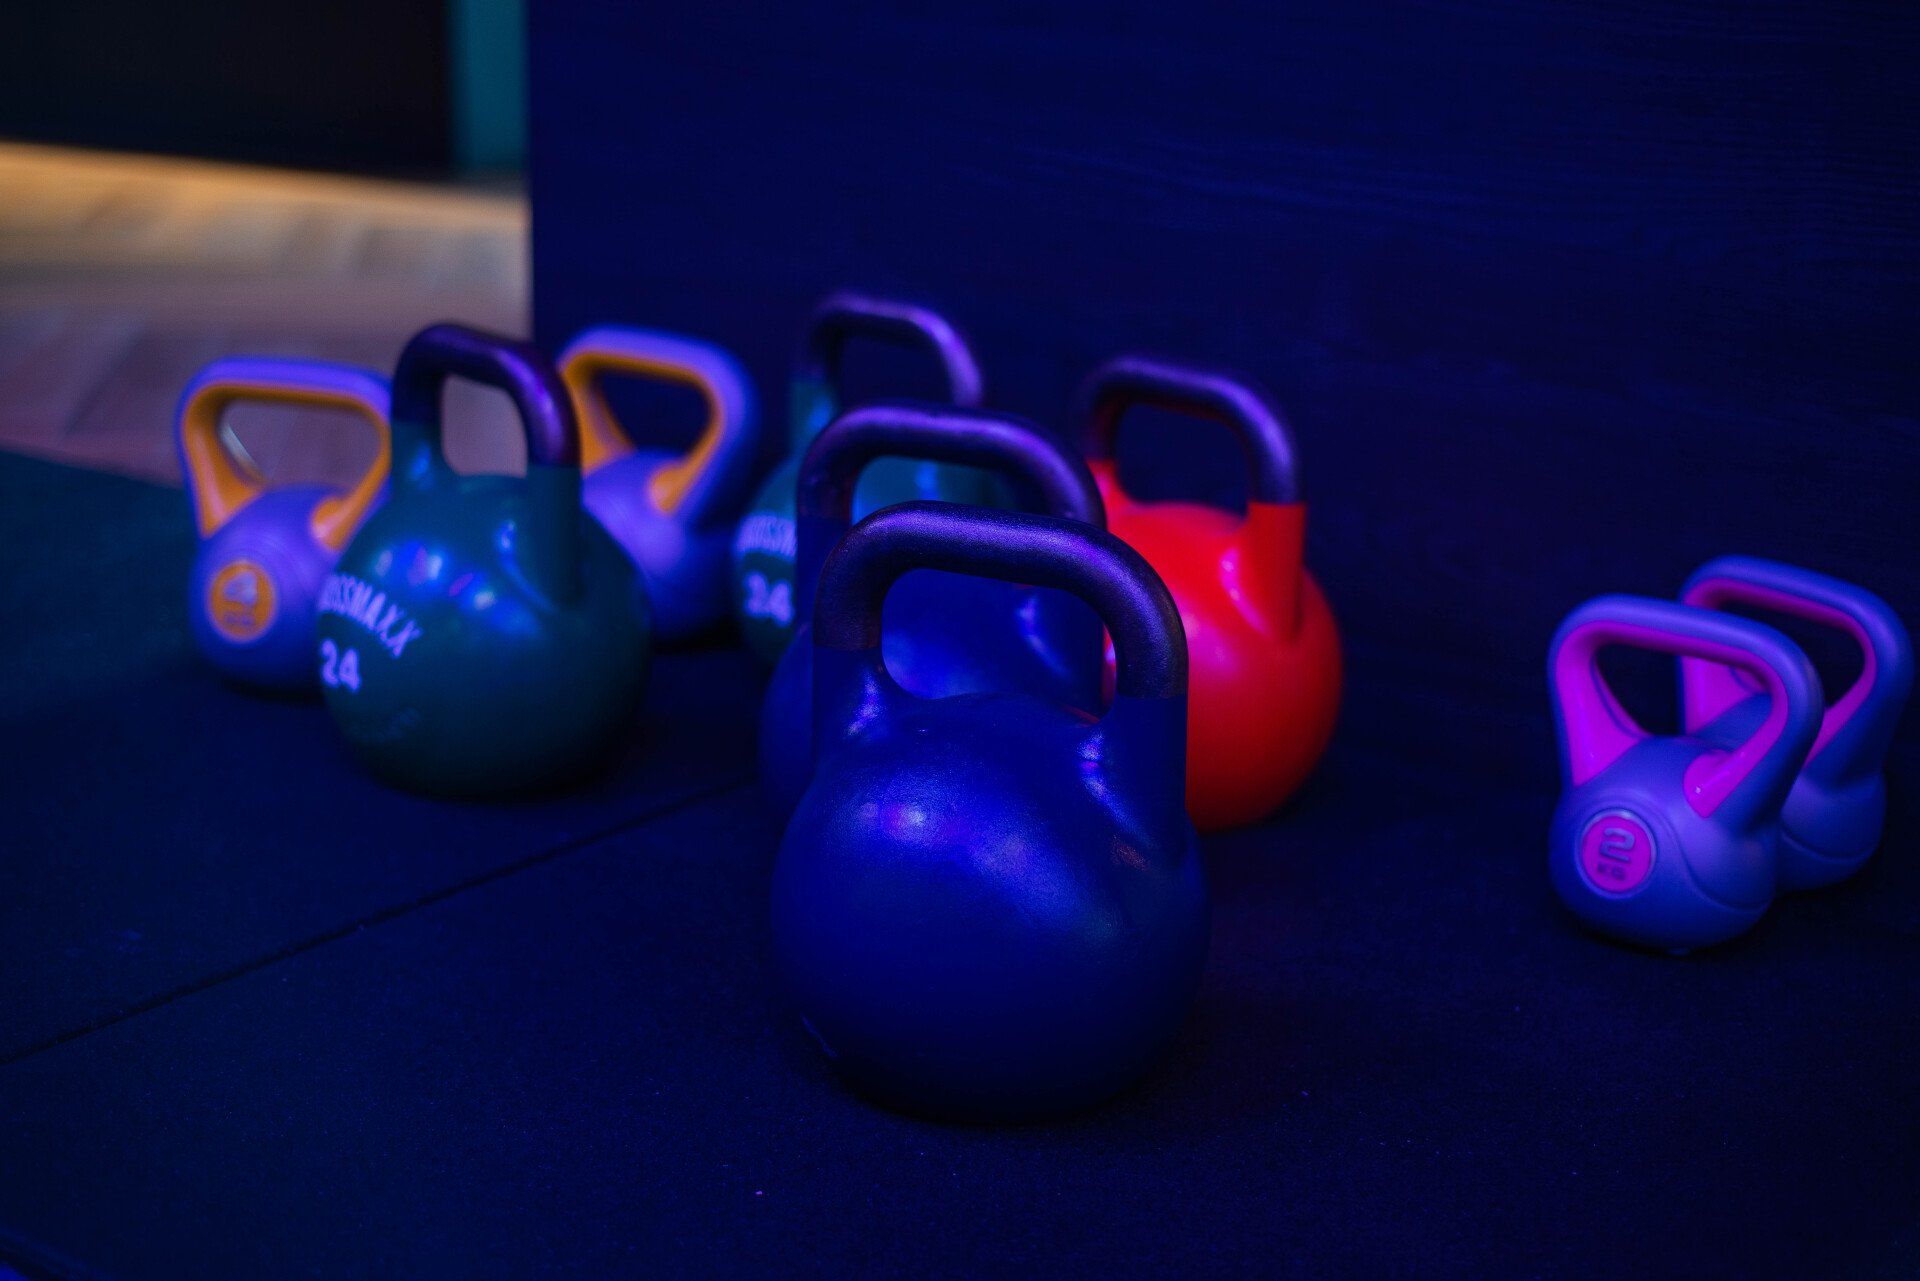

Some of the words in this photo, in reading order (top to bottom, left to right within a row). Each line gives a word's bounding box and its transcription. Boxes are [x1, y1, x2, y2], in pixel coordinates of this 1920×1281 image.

[747, 573, 792, 623] 24
[321, 639, 361, 691] 24
[1600, 827, 1636, 863] 2
